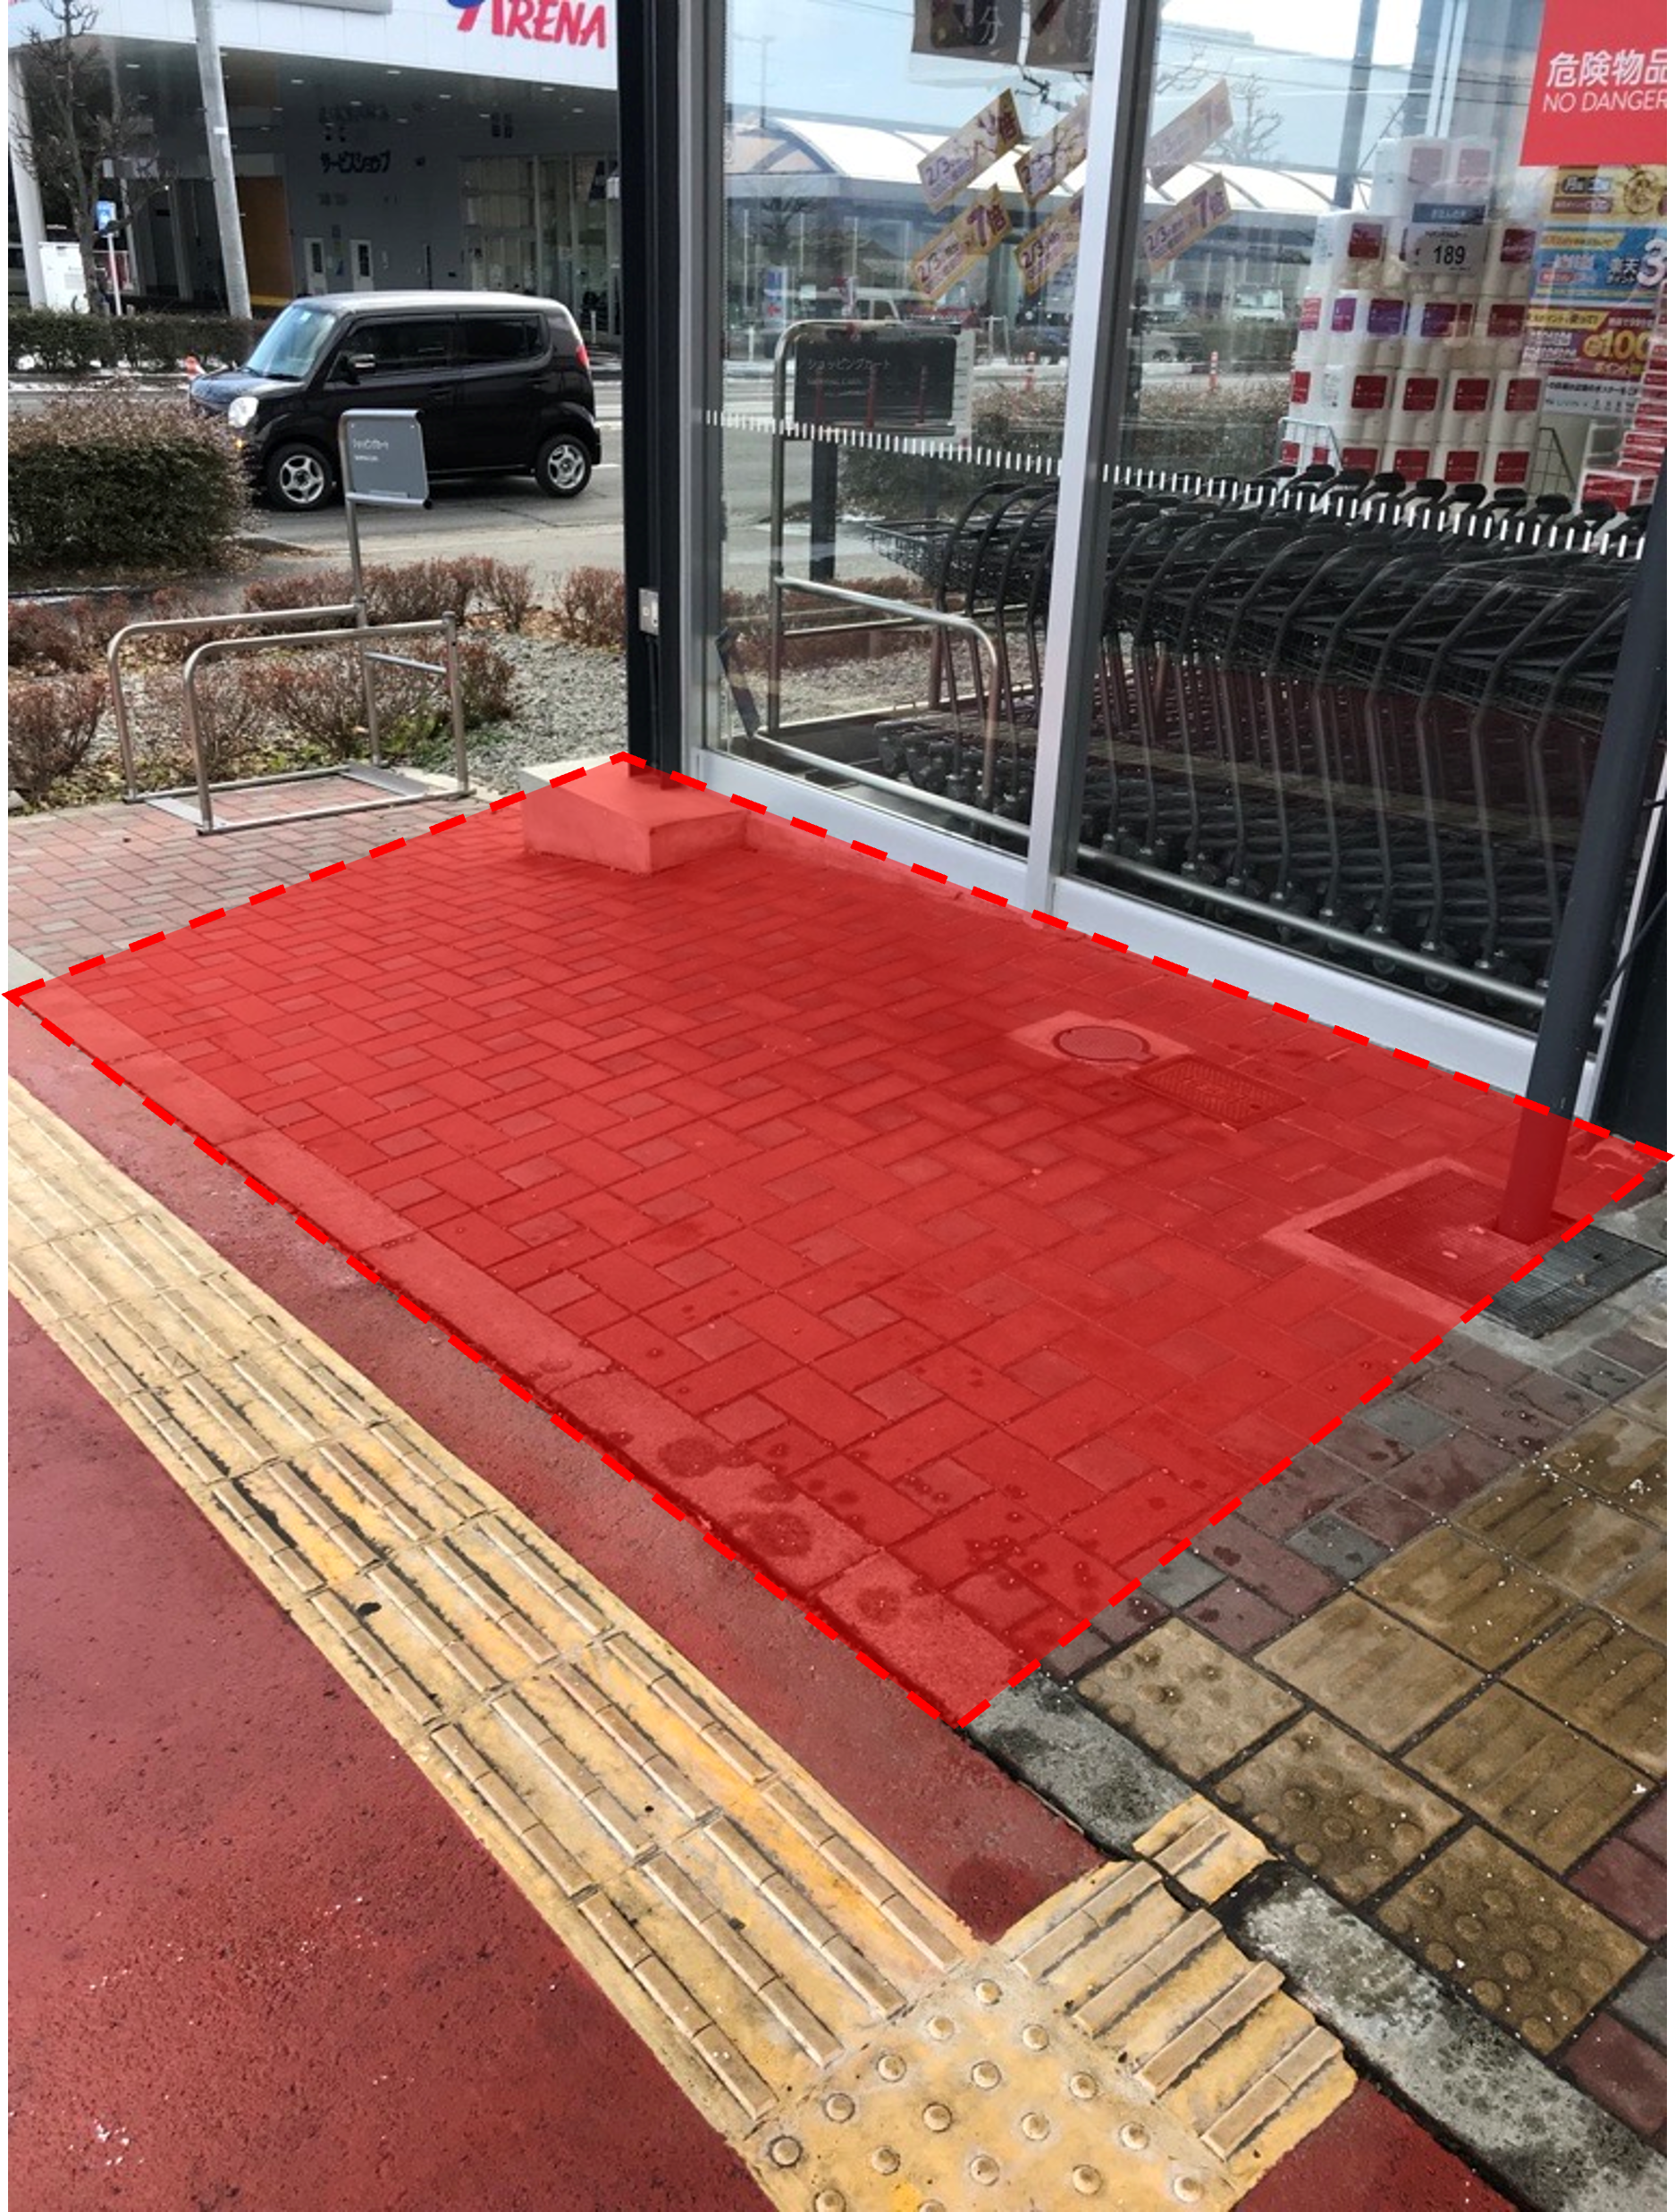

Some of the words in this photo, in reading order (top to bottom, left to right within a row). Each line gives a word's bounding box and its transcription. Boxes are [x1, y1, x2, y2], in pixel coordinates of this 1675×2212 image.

[1546, 49, 1667, 88] 危険物品
[1543, 91, 1577, 114] NO
[1580, 88, 1667, 113] DANGER
[1433, 245, 1467, 265] 189
